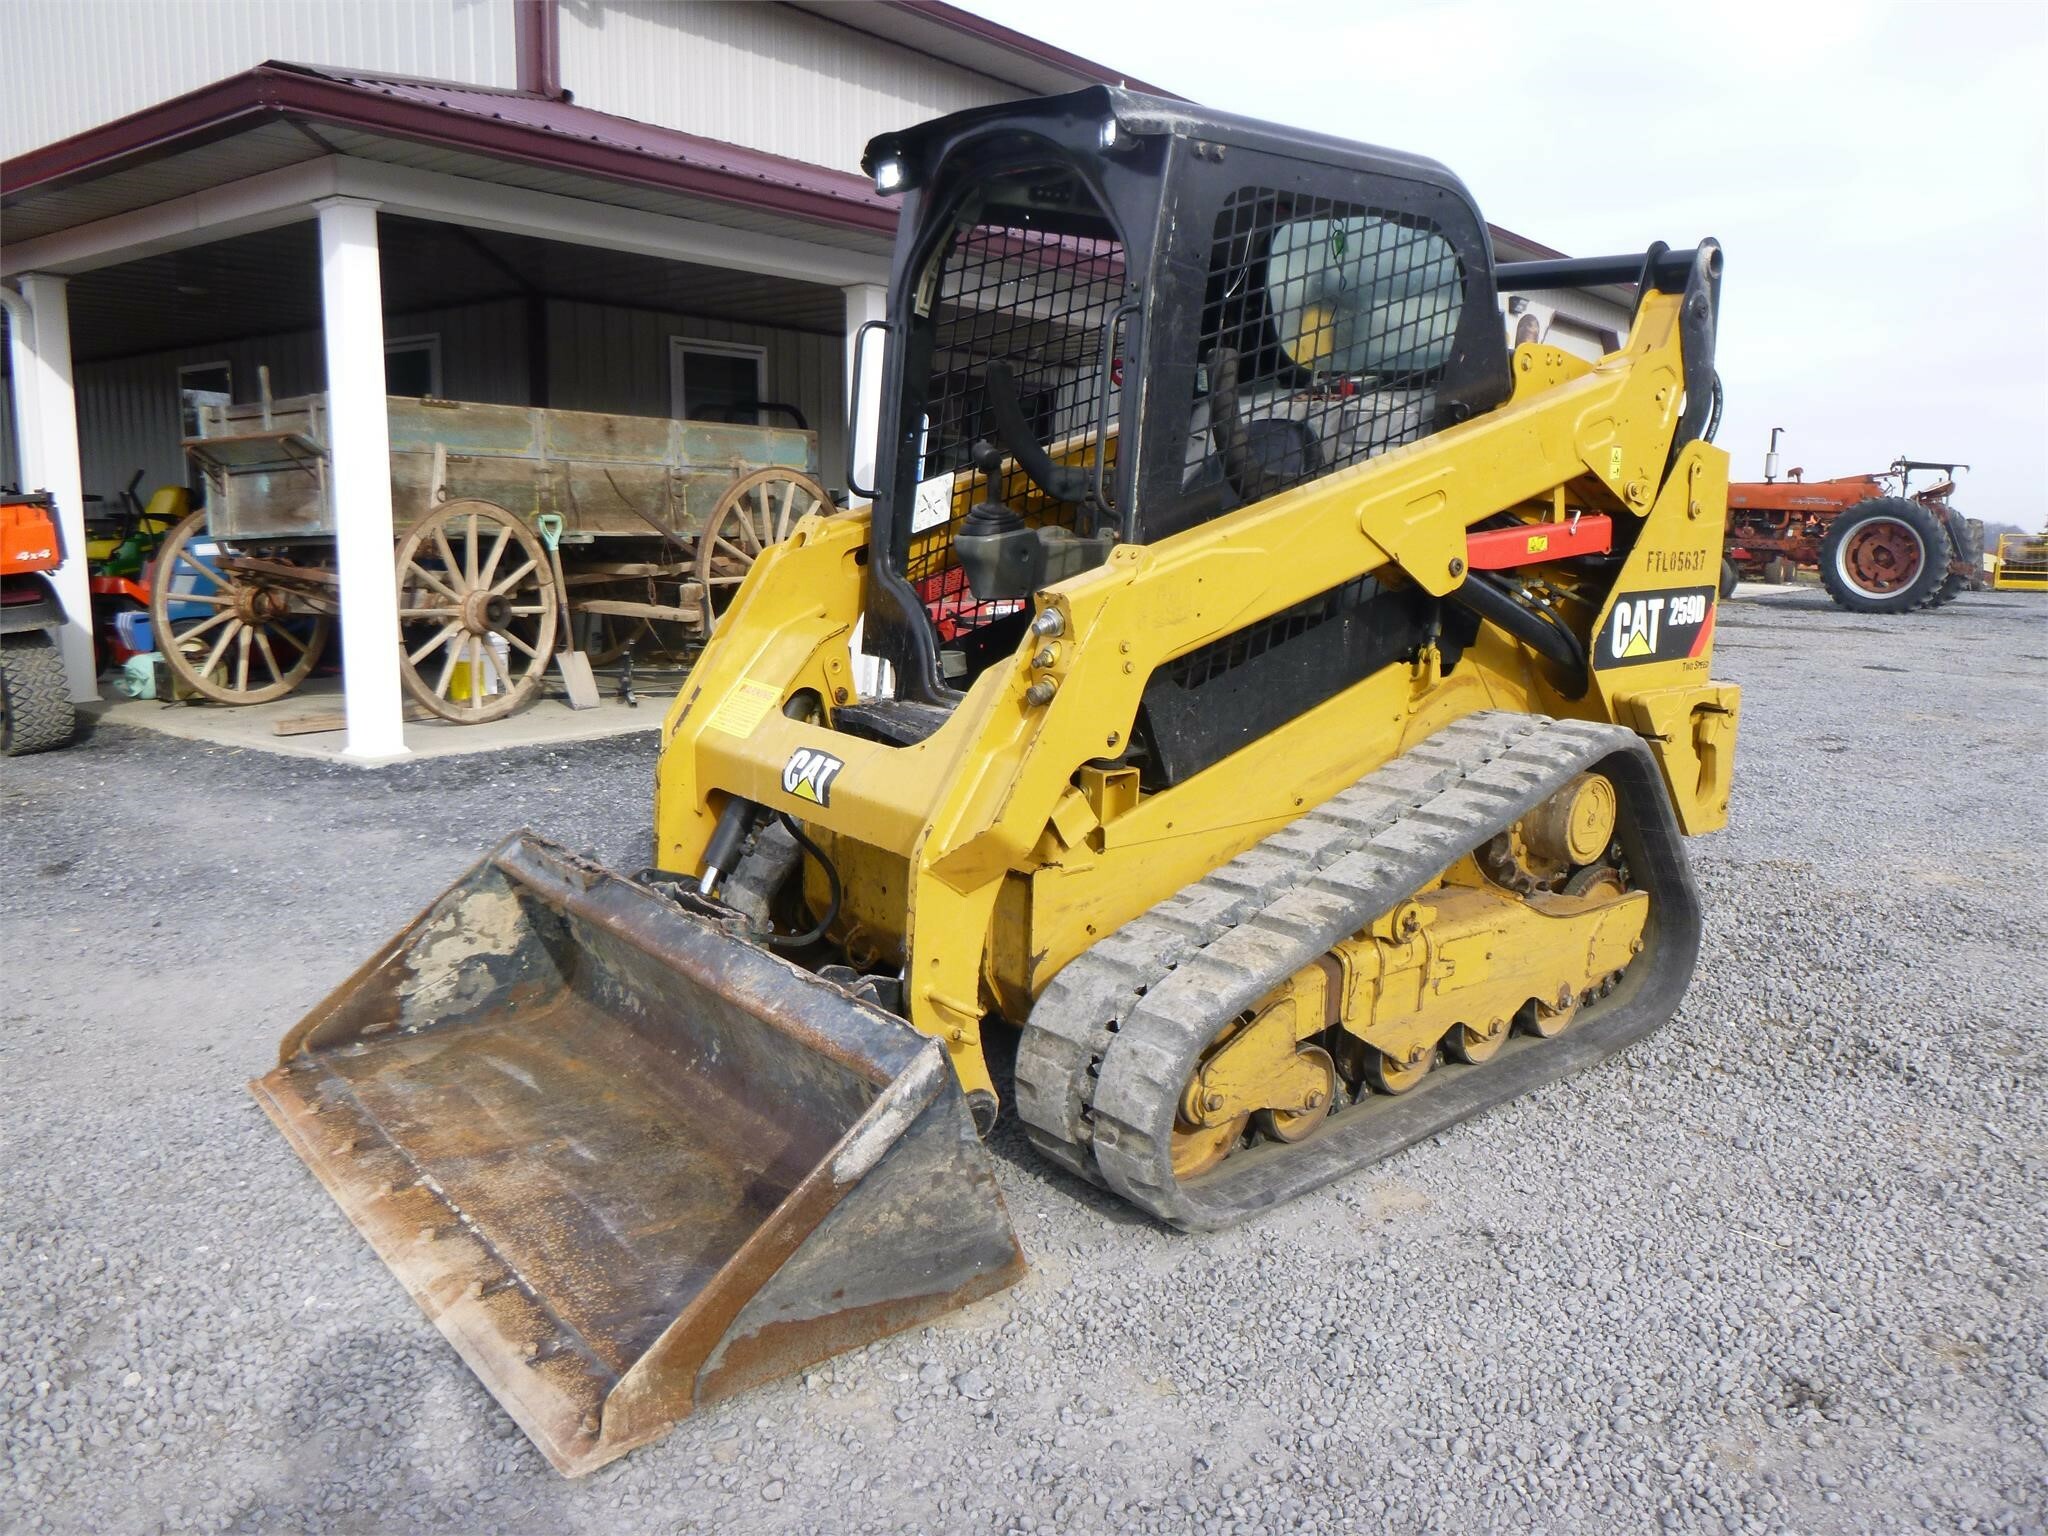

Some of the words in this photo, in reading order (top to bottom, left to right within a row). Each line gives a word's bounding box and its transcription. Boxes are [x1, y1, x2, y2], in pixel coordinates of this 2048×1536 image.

[15, 548, 52, 561] 4x4
[1646, 549, 1707, 573] FTL05637
[1611, 598, 1665, 659] CAT
[1668, 595, 1706, 626] 259D
[784, 749, 842, 805] CAT
